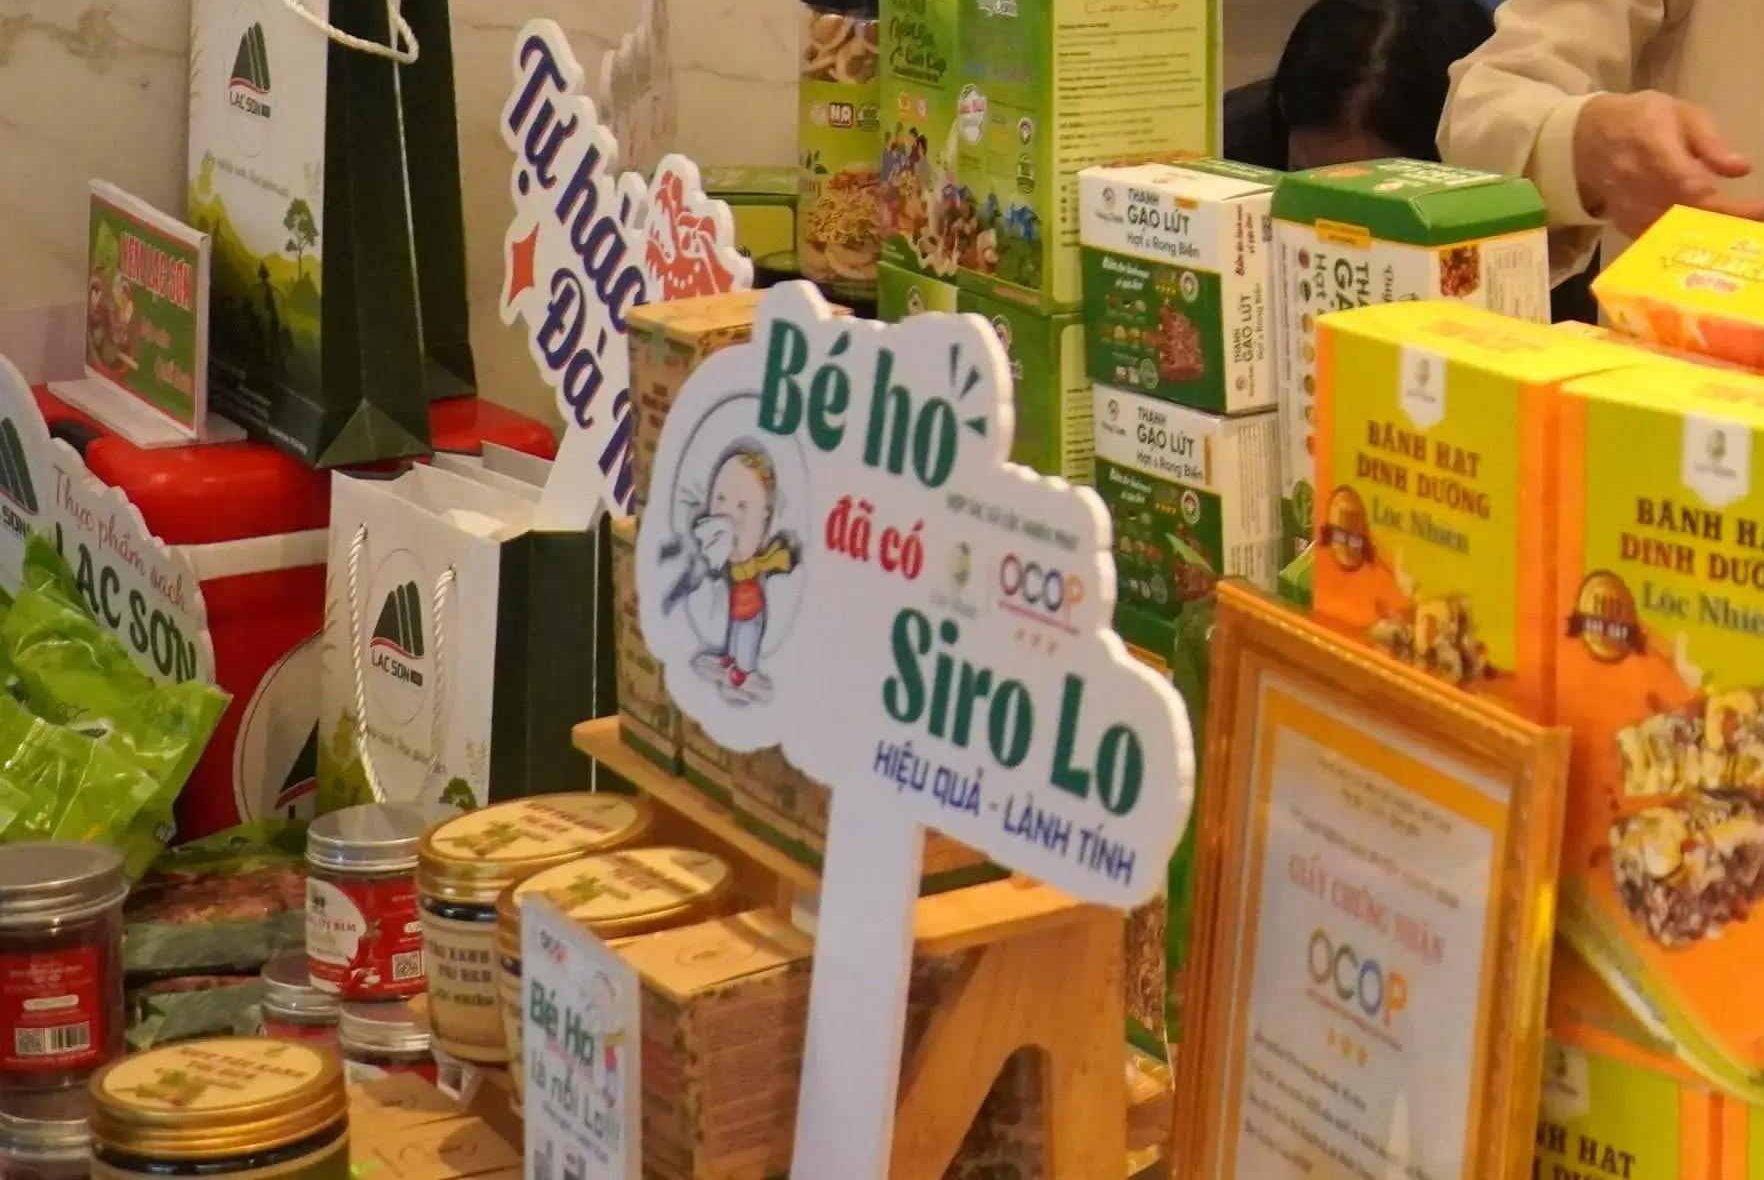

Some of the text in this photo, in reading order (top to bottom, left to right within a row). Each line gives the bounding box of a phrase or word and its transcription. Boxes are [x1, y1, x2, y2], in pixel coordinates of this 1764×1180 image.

[507, 34, 578, 197] Tự
[536, 267, 608, 429] Đà
[757, 317, 959, 491] Bé ho
[824, 494, 874, 565] đã
[878, 518, 925, 582] có
[1000, 552, 1086, 625] OCOP
[1619, 531, 1696, 576] DINH
[882, 606, 1036, 769] Siro
[1048, 672, 1145, 818] Lo
[873, 736, 930, 797] HIỆU
[932, 762, 983, 821] QUẢ
[1002, 798, 1071, 857] LÀNH
[1077, 821, 1137, 888] TÍNH
[1308, 927, 1410, 1027] OCOP
